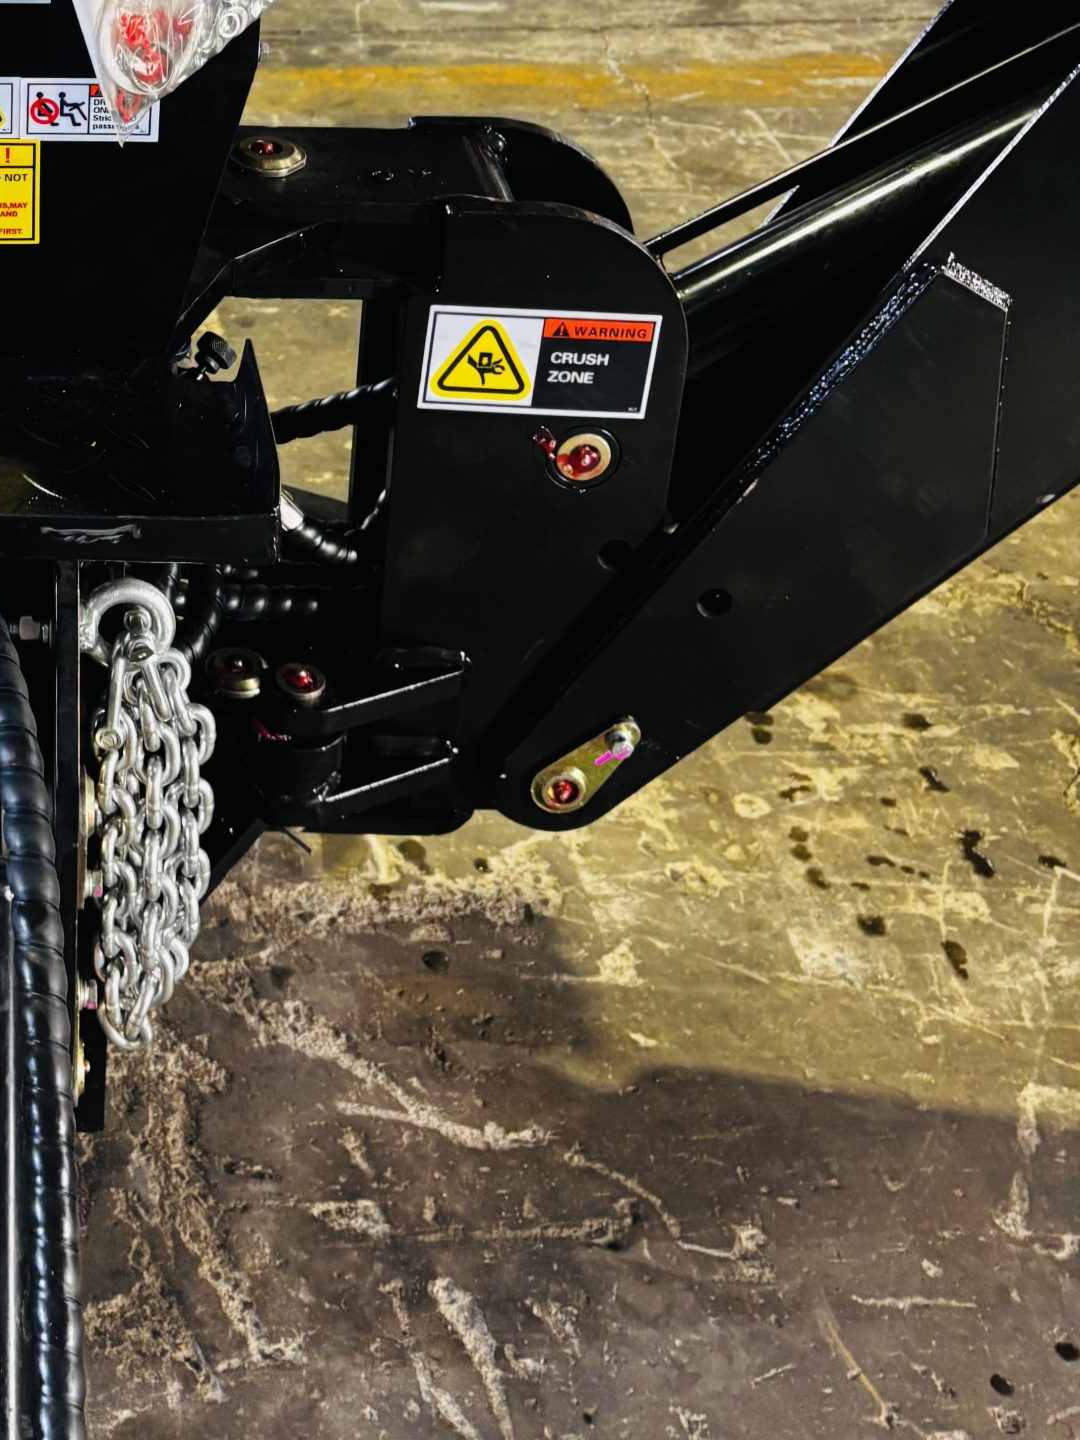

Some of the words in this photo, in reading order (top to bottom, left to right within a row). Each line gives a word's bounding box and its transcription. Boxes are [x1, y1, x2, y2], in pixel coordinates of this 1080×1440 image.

[4, 173, 28, 182] NOT
[574, 325, 648, 340] WARNING
[550, 351, 610, 366] CRUSH
[546, 370, 595, 385] ZONE
